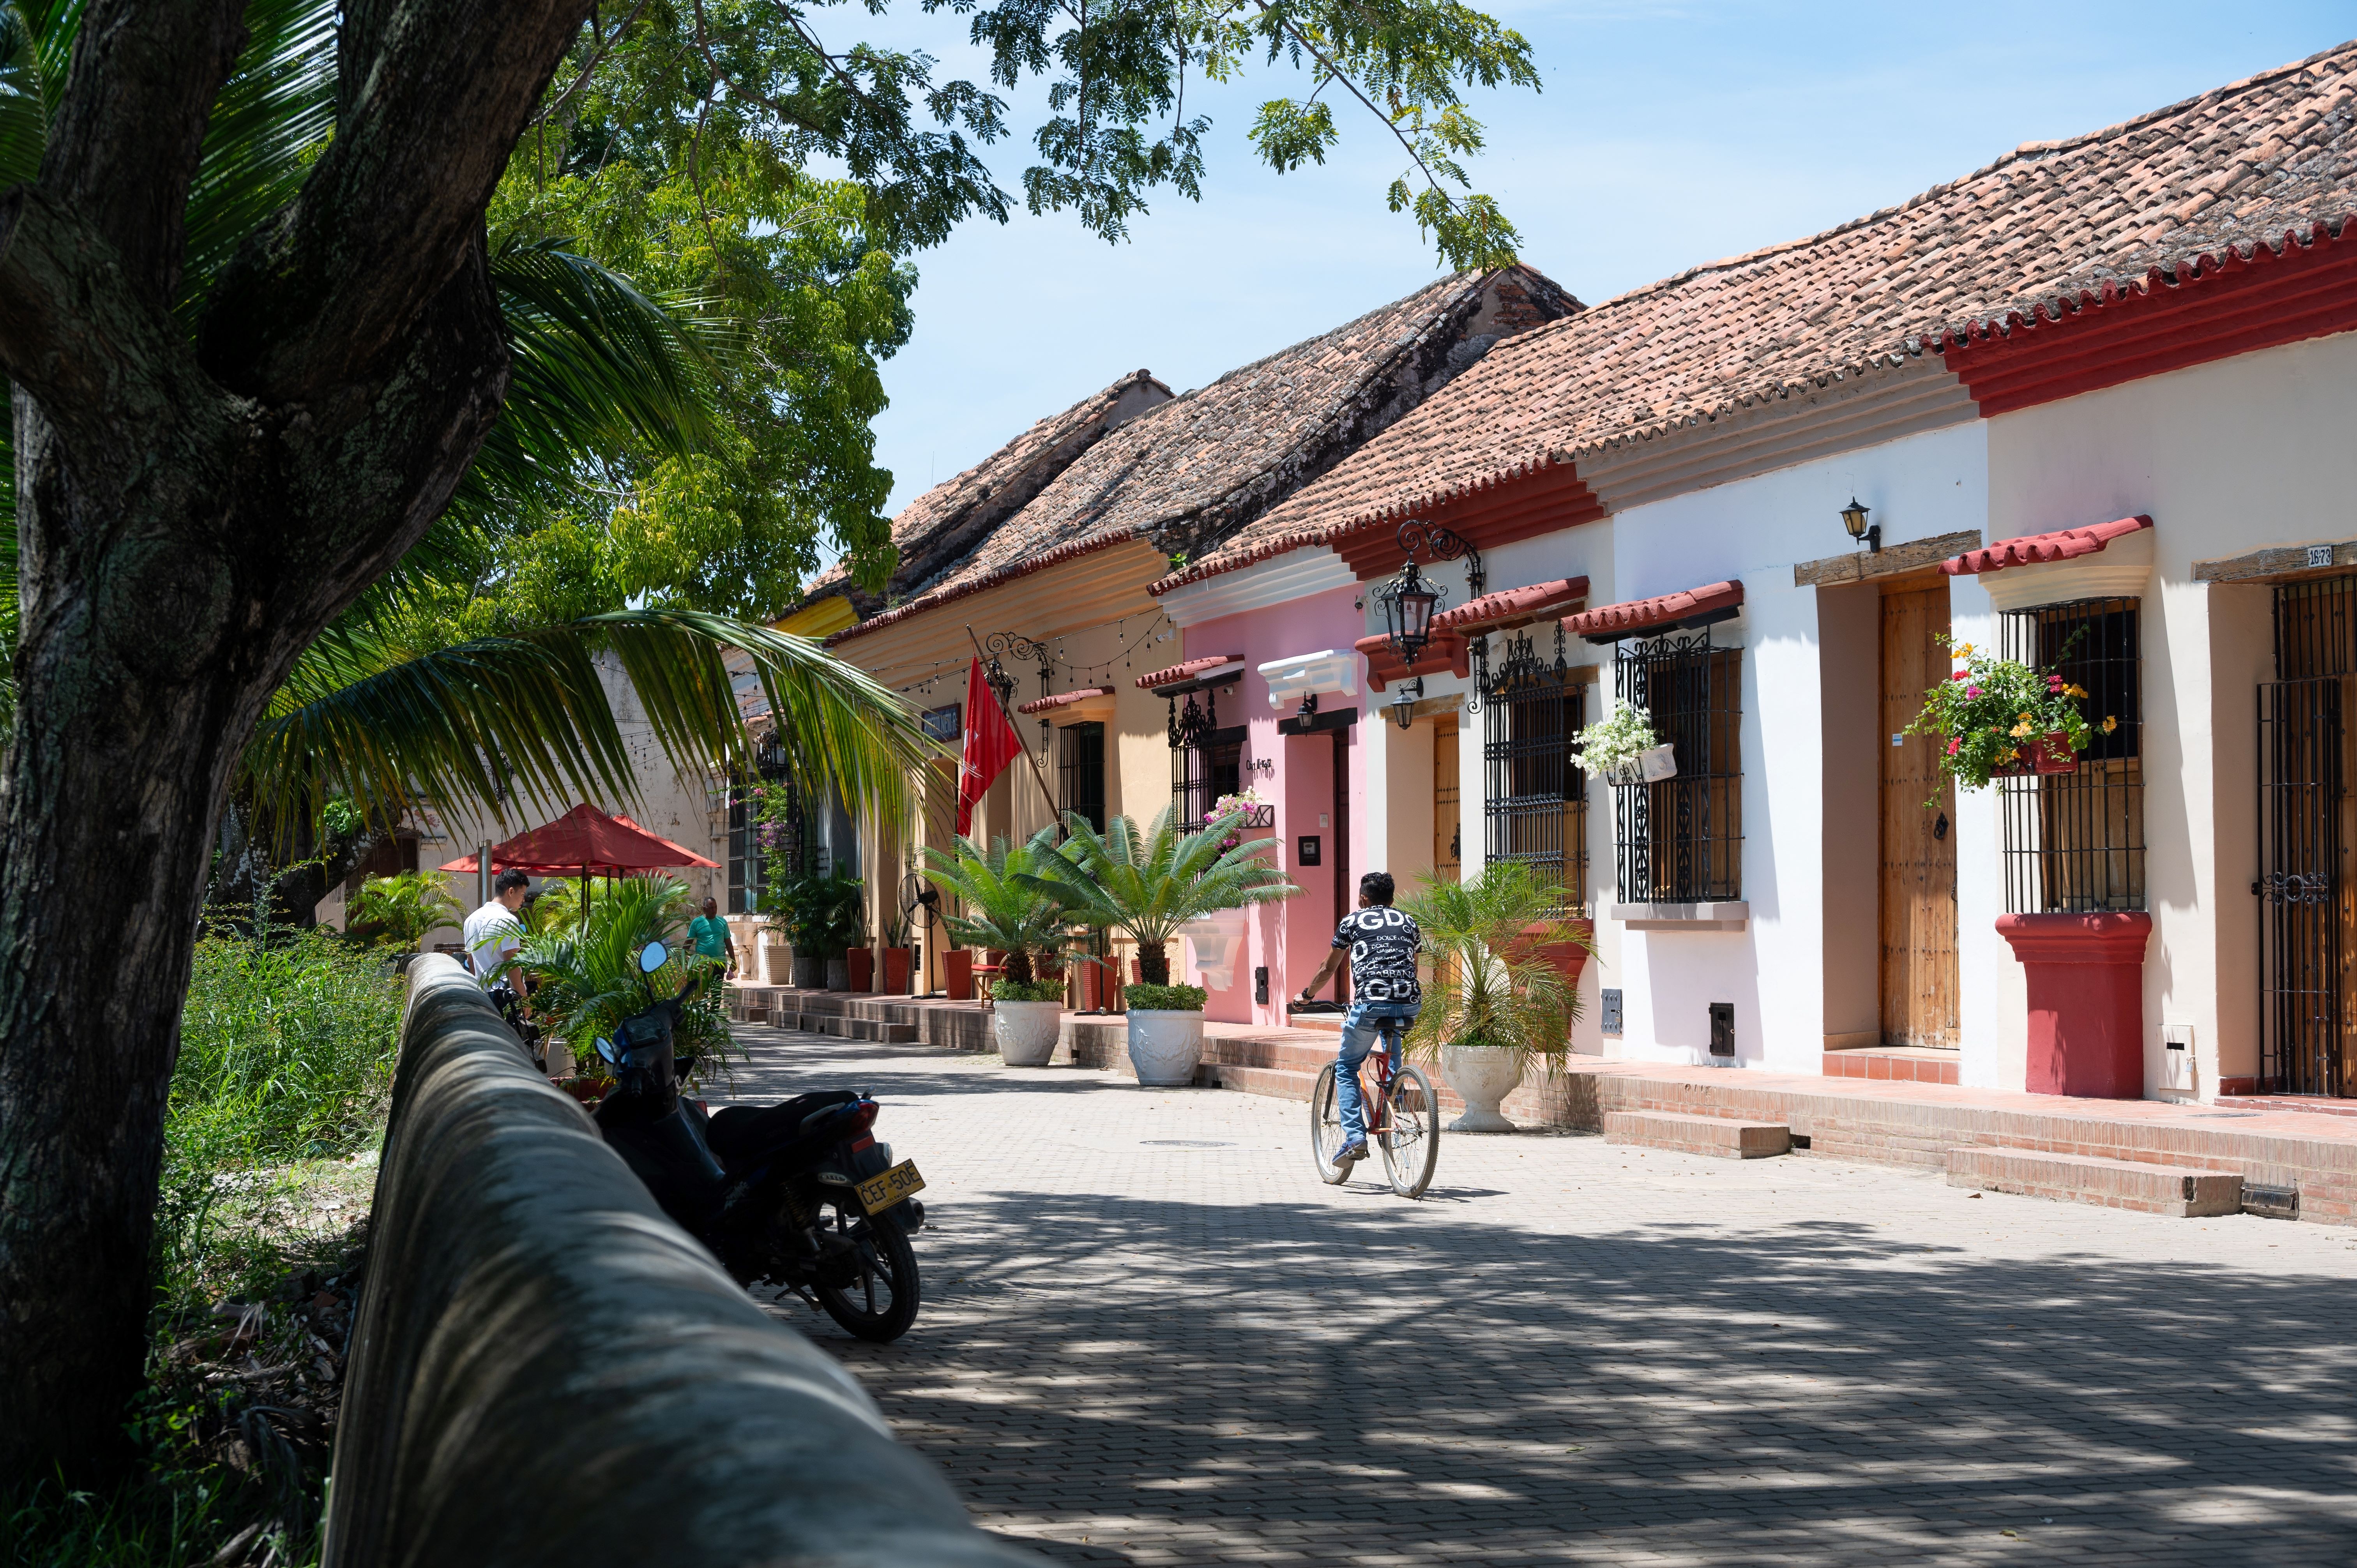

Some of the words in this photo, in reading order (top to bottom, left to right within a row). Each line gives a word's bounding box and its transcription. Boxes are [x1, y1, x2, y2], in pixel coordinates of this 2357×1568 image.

[924, 716, 940, 736] ROBERTO
[941, 713, 952, 733] NIETO
[1366, 969, 1415, 979] GABBANA
[860, 1180, 886, 1205] CEF
